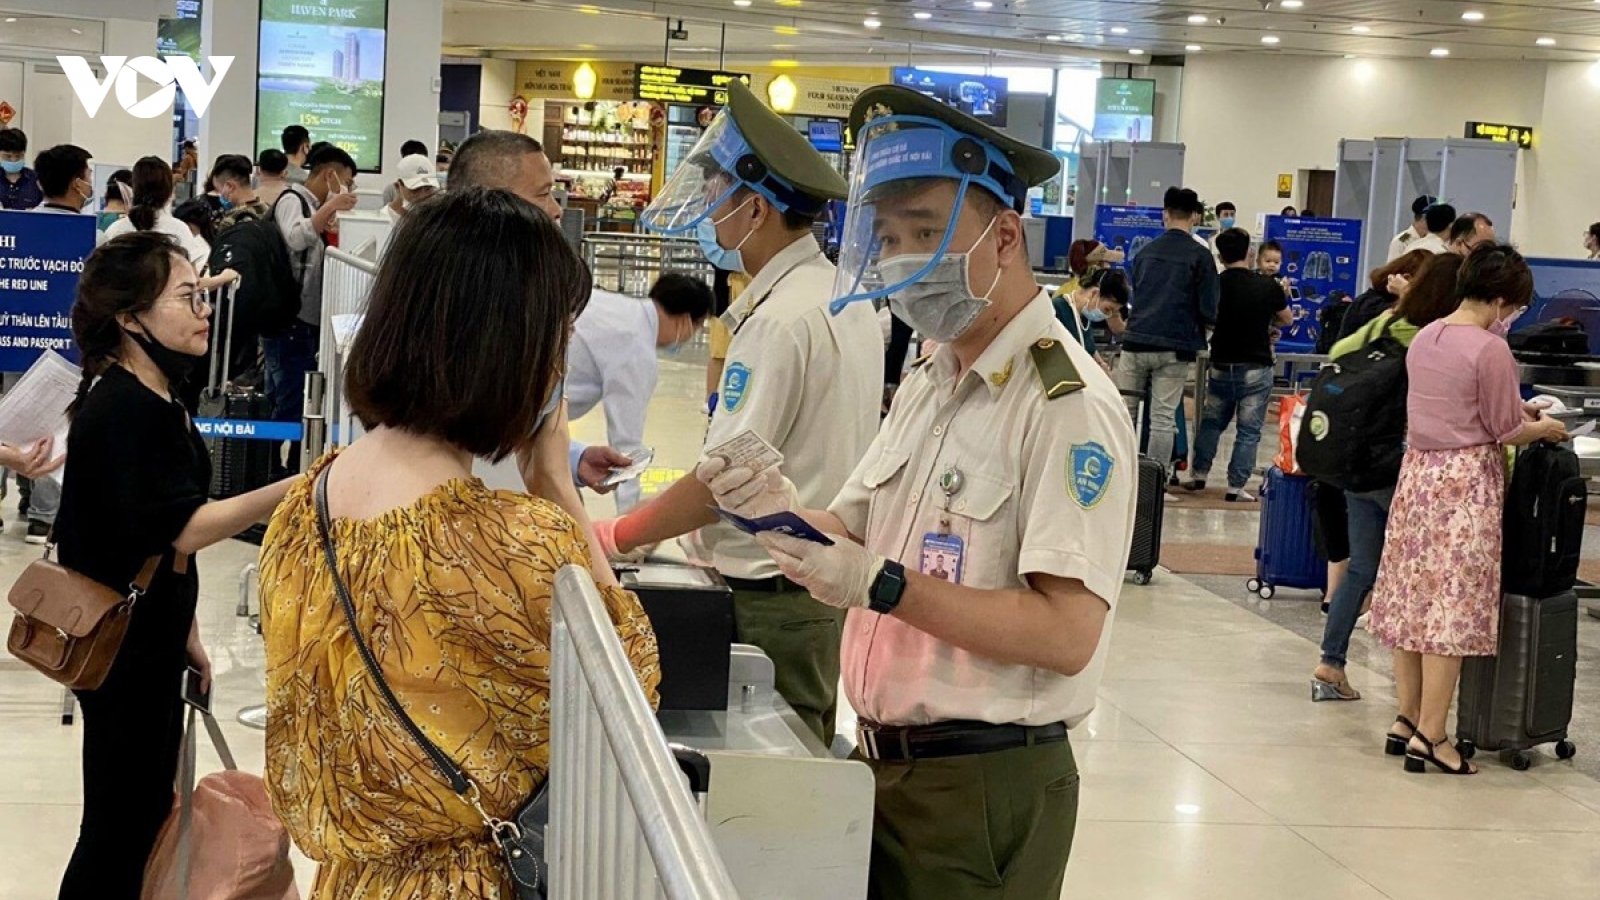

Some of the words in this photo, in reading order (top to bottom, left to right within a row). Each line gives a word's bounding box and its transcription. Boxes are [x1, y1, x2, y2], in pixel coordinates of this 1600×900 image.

[291, 5, 327, 16] HAVEN
[328, 8, 357, 18] PARK
[8, 255, 40, 271] TRƯỚC
[42, 259, 69, 275] VẠCH
[70, 256, 85, 273] ĐỎ
[11, 279, 28, 290] RED
[30, 280, 48, 291] LINE
[11, 312, 33, 327] THÂN
[34, 313, 50, 328] LÊN
[12, 337, 29, 347] AND
[30, 337, 72, 350] PASSPORT
[214, 421, 233, 436] NỘI
[235, 422, 256, 435] BÀI
